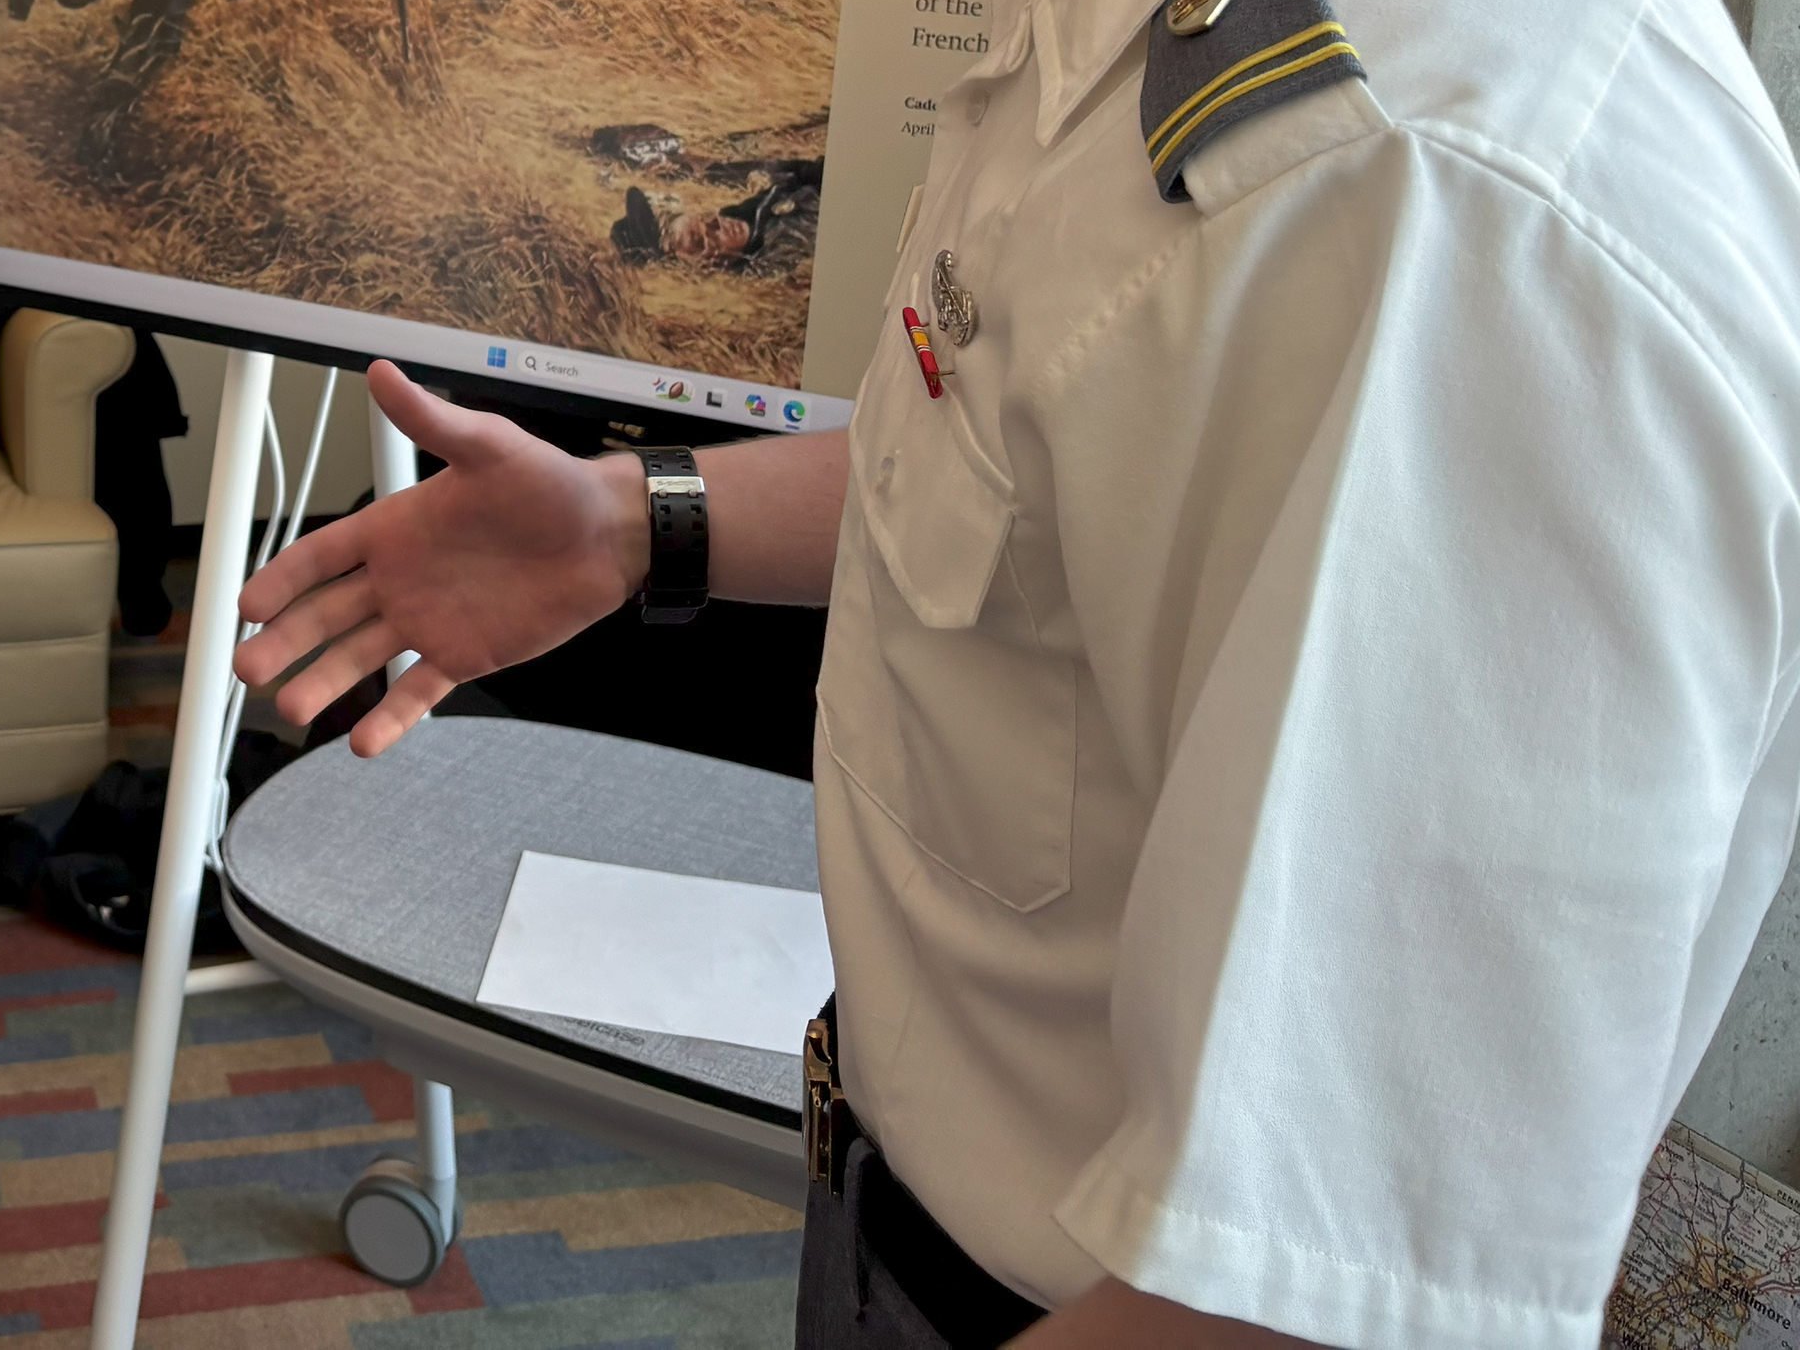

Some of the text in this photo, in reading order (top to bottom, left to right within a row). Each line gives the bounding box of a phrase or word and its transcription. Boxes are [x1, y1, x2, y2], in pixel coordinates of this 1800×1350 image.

[912, 27, 989, 53] French
[901, 121, 934, 138] April
[545, 361, 578, 377] Search
